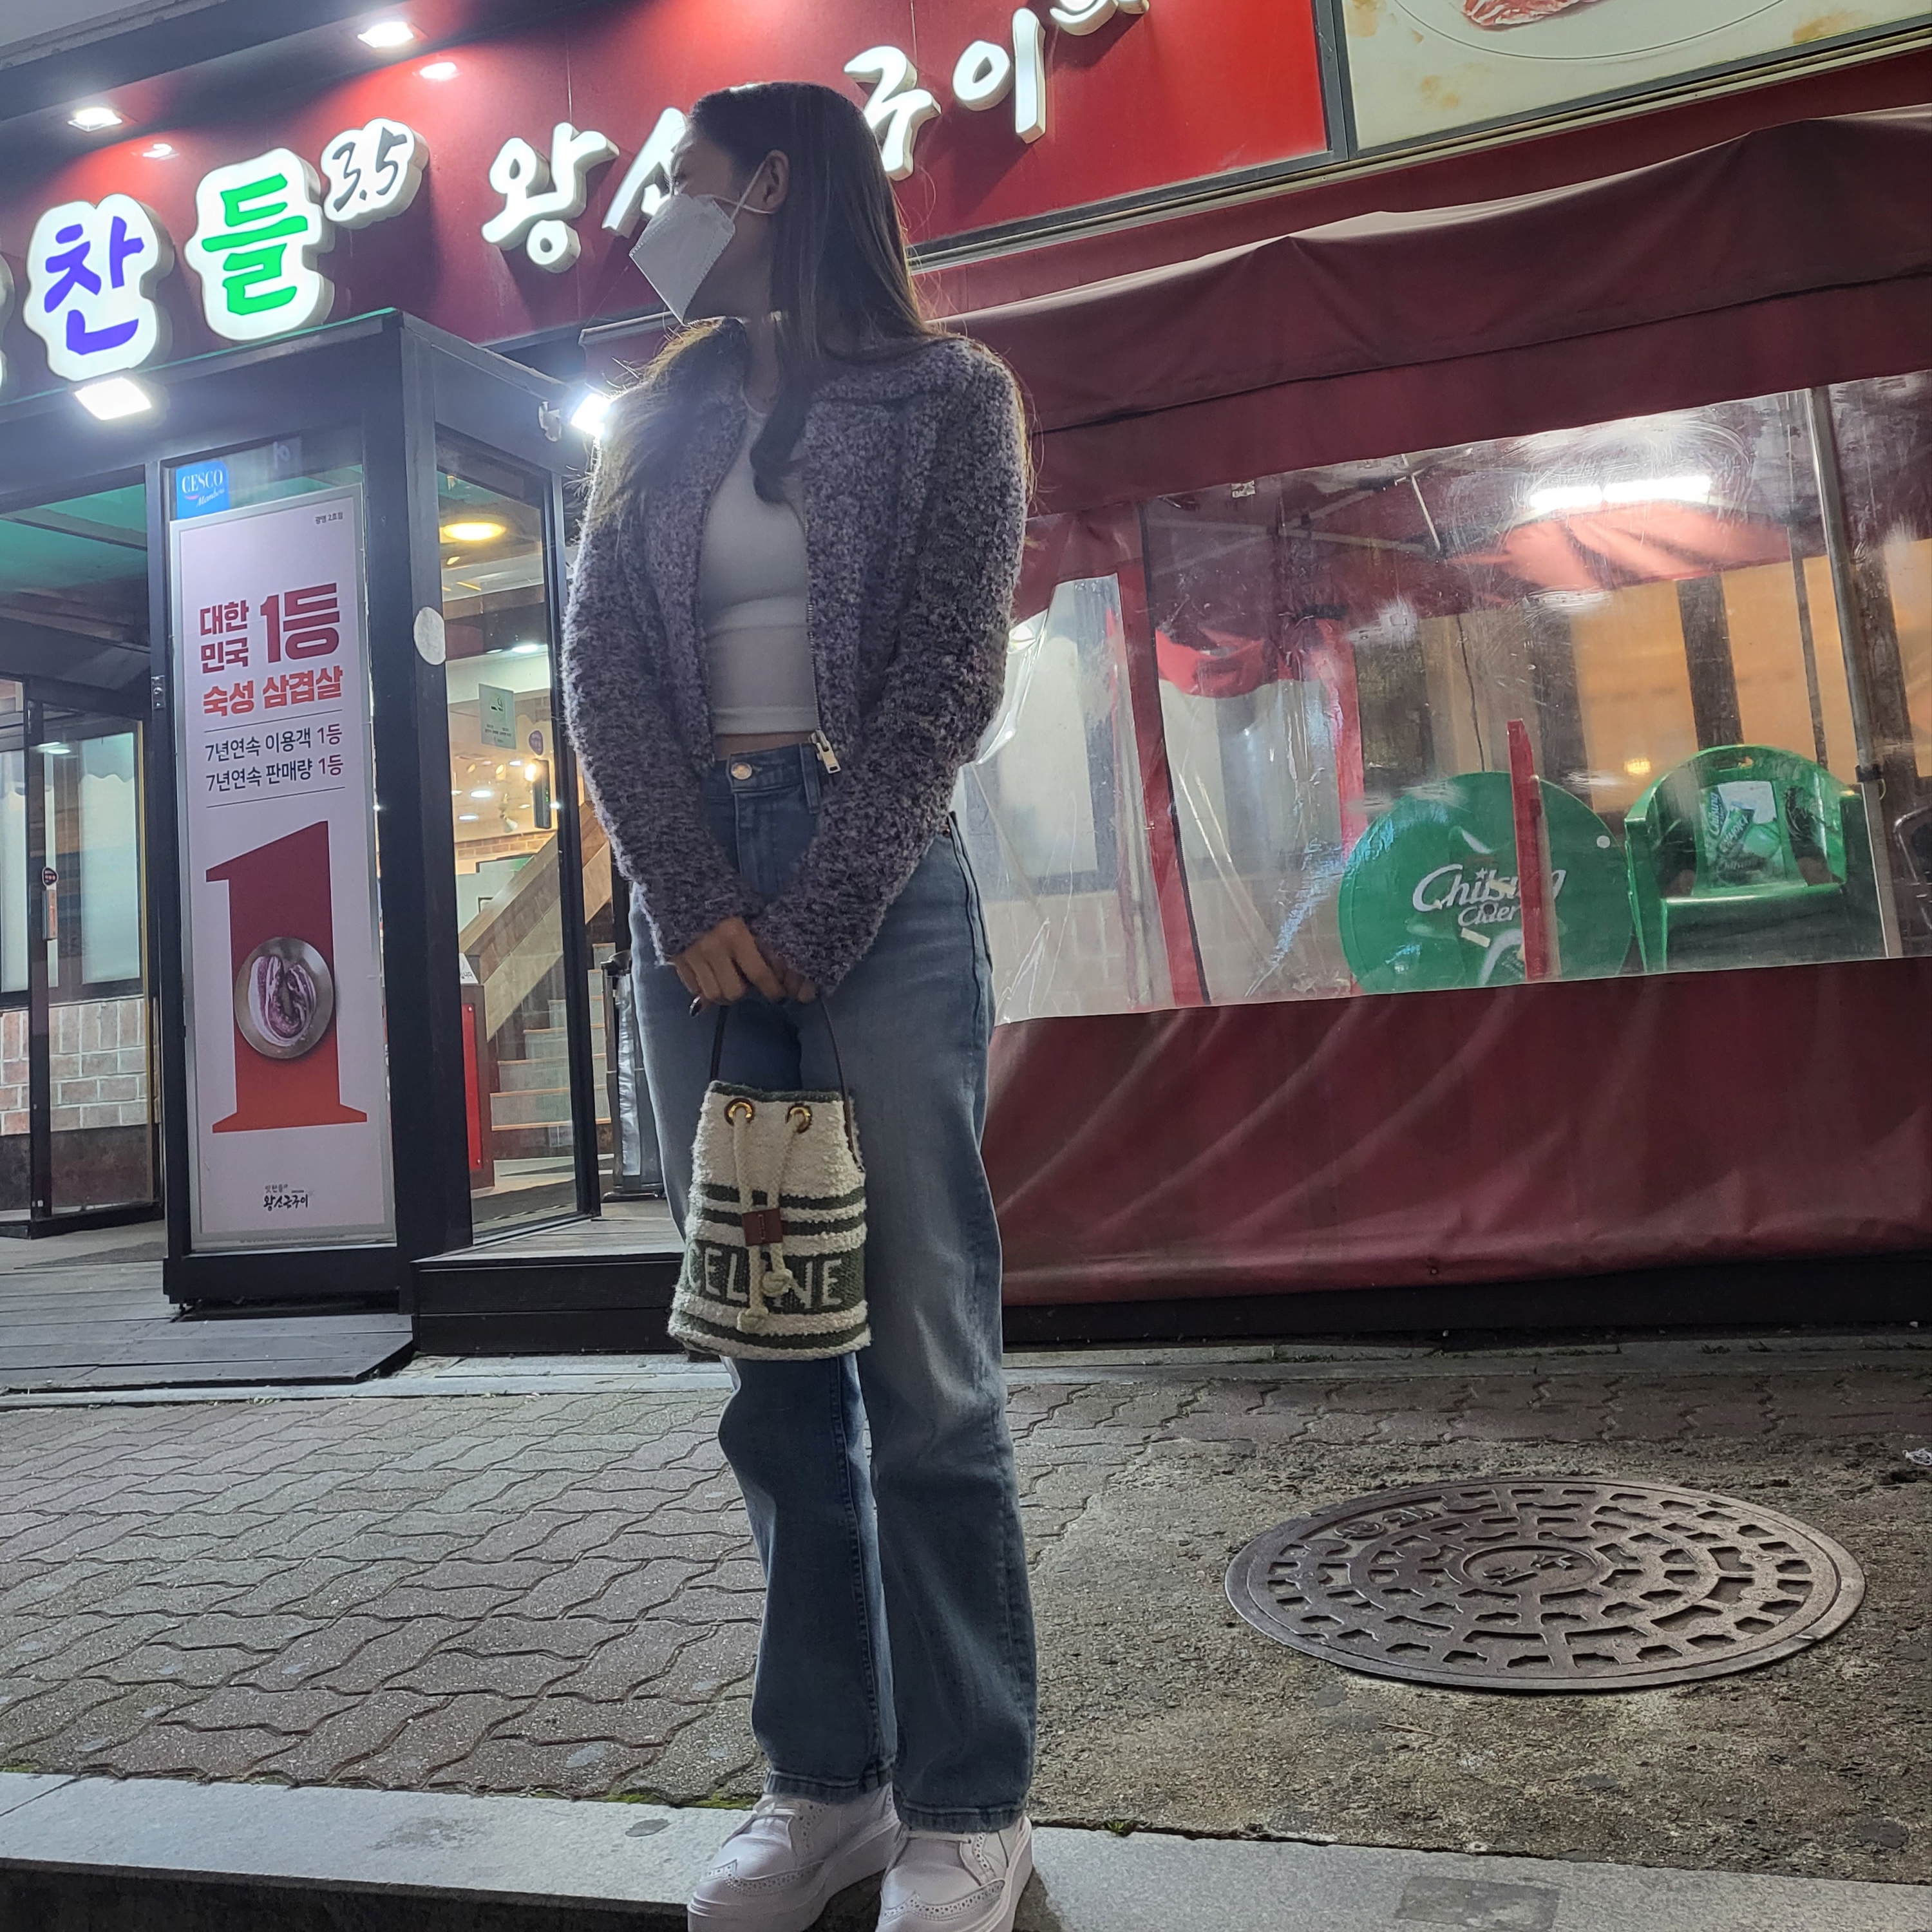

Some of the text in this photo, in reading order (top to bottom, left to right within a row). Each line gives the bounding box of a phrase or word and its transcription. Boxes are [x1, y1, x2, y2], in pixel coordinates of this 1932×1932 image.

[332, 126, 408, 212] 3.5
[182, 469, 223, 494] CESCO
[200, 599, 250, 636] 대한
[260, 582, 341, 664] 1등
[200, 636, 249, 674] 민국
[203, 665, 343, 717] 숙성 삼겹살
[204, 723, 343, 762] 7년연속 이용객 1등
[205, 753, 344, 792] 7년연속 판매량 1등
